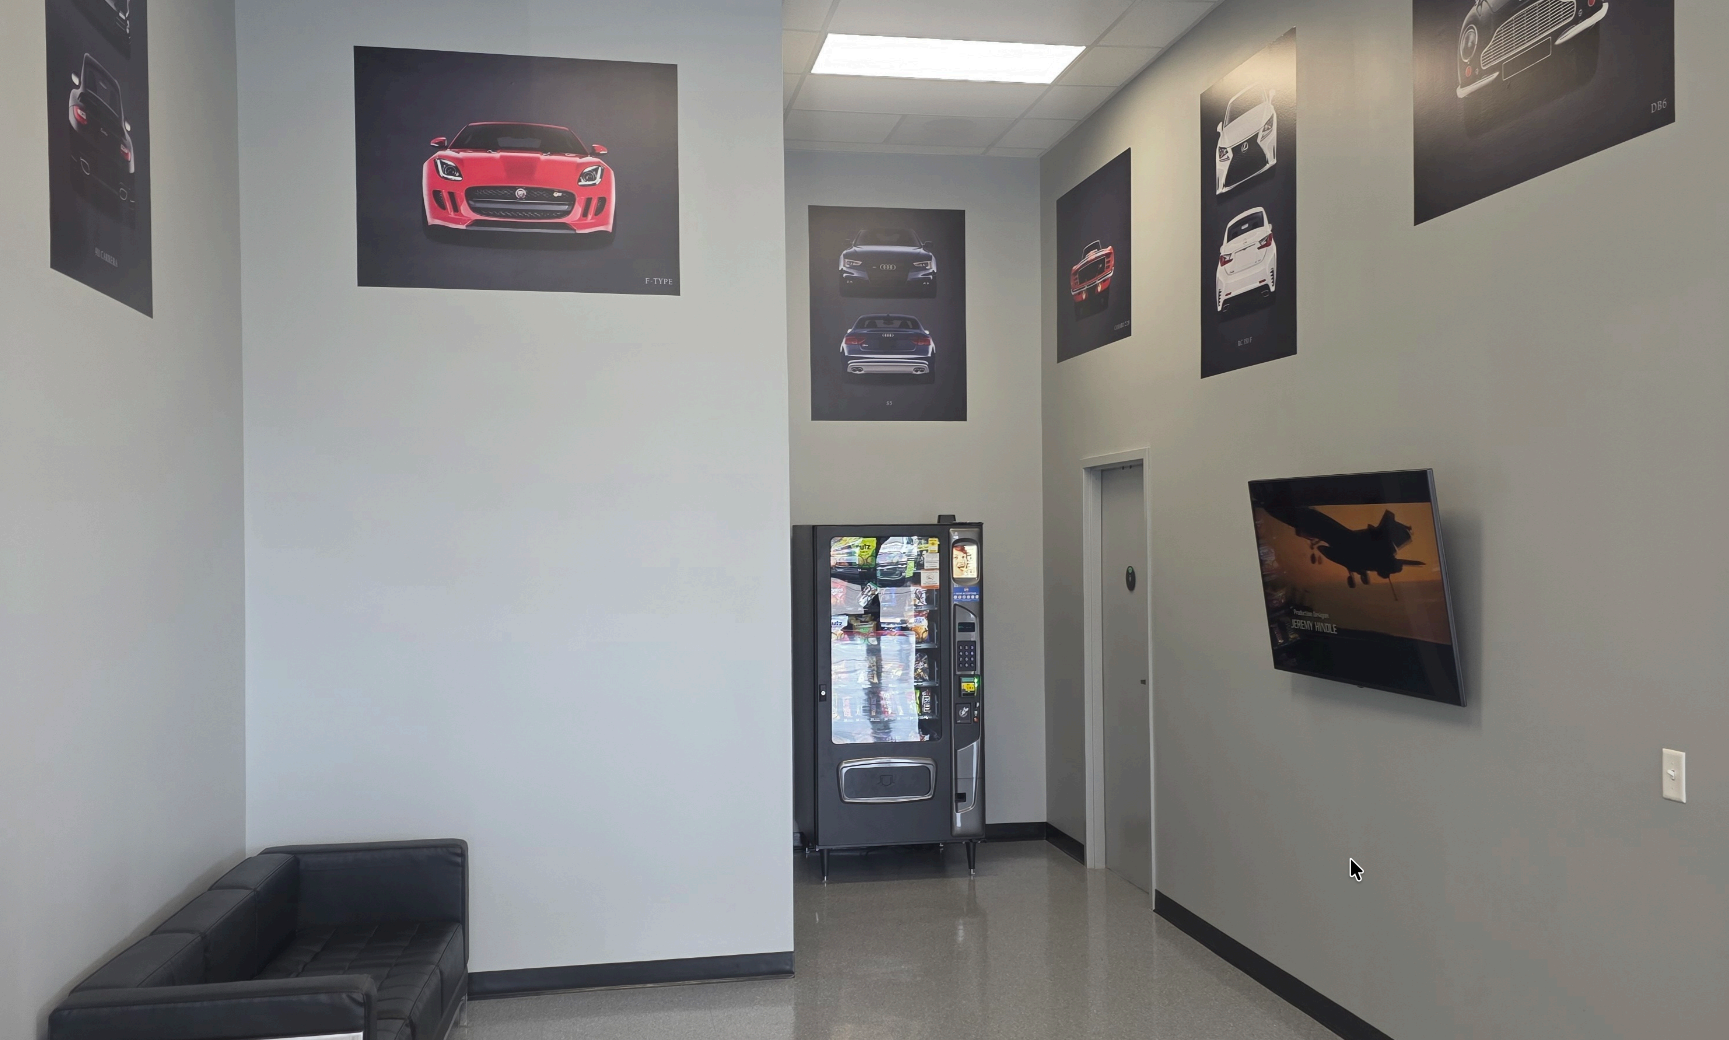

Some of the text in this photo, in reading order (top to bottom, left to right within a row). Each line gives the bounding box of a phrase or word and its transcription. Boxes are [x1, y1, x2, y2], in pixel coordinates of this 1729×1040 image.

[1651, 98, 1667, 113] DB6
[645, 277, 673, 285] F-TYPE
[1291, 619, 1338, 634] JEREMY HINDLE
